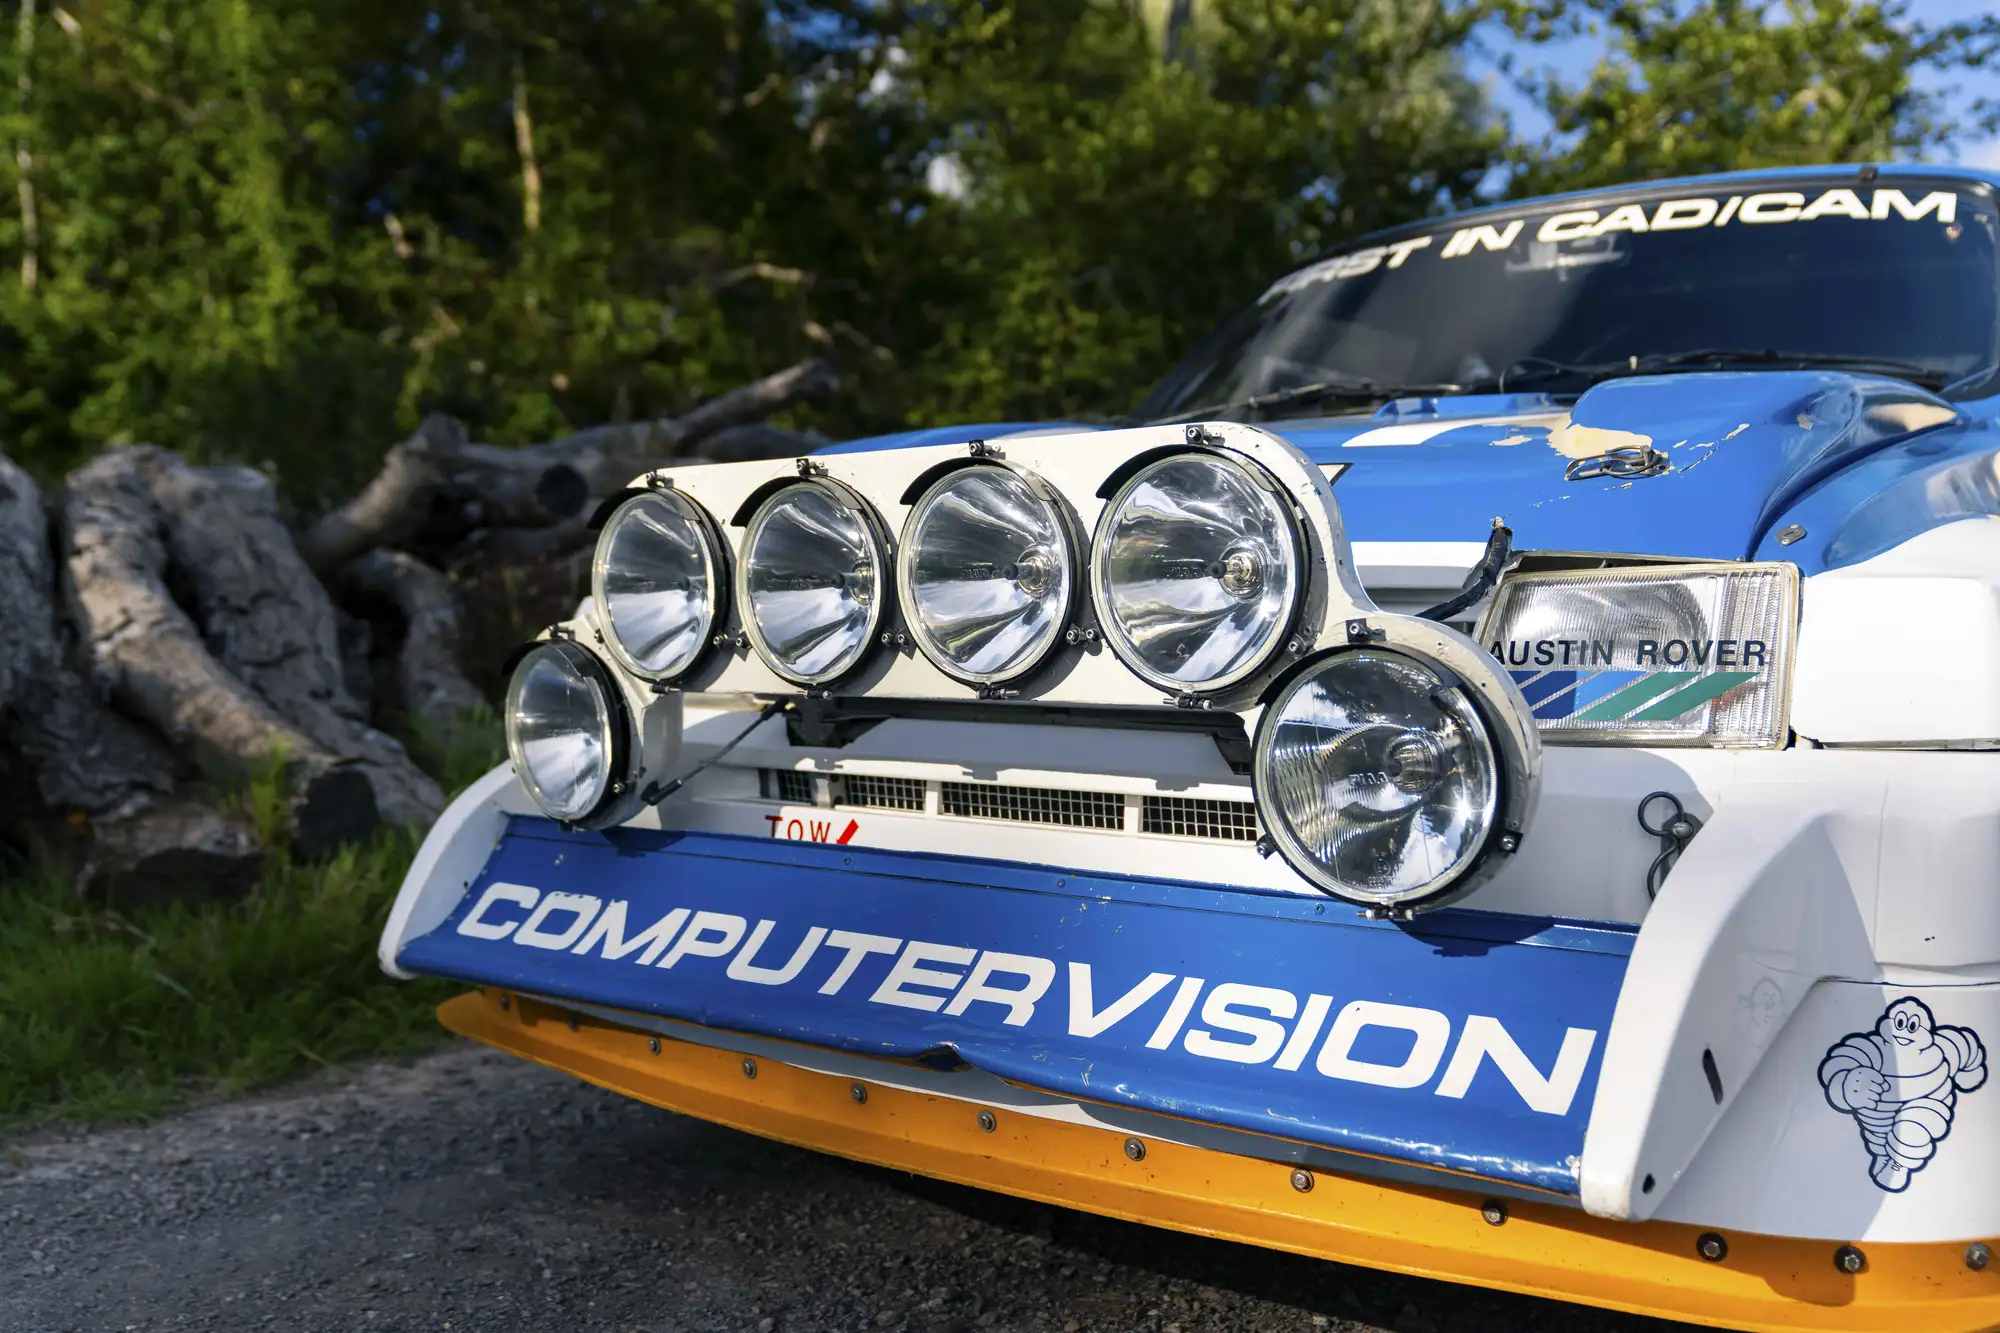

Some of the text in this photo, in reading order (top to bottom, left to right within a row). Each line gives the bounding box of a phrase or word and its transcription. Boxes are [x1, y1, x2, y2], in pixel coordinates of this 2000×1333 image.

[1440, 219, 1525, 259] IN
[1537, 188, 1958, 243] CAD/CAM
[1490, 639, 1766, 666] AUSTIN ROVER
[764, 815, 831, 843] TOW
[456, 881, 1597, 1117] COMPUTERVISION
